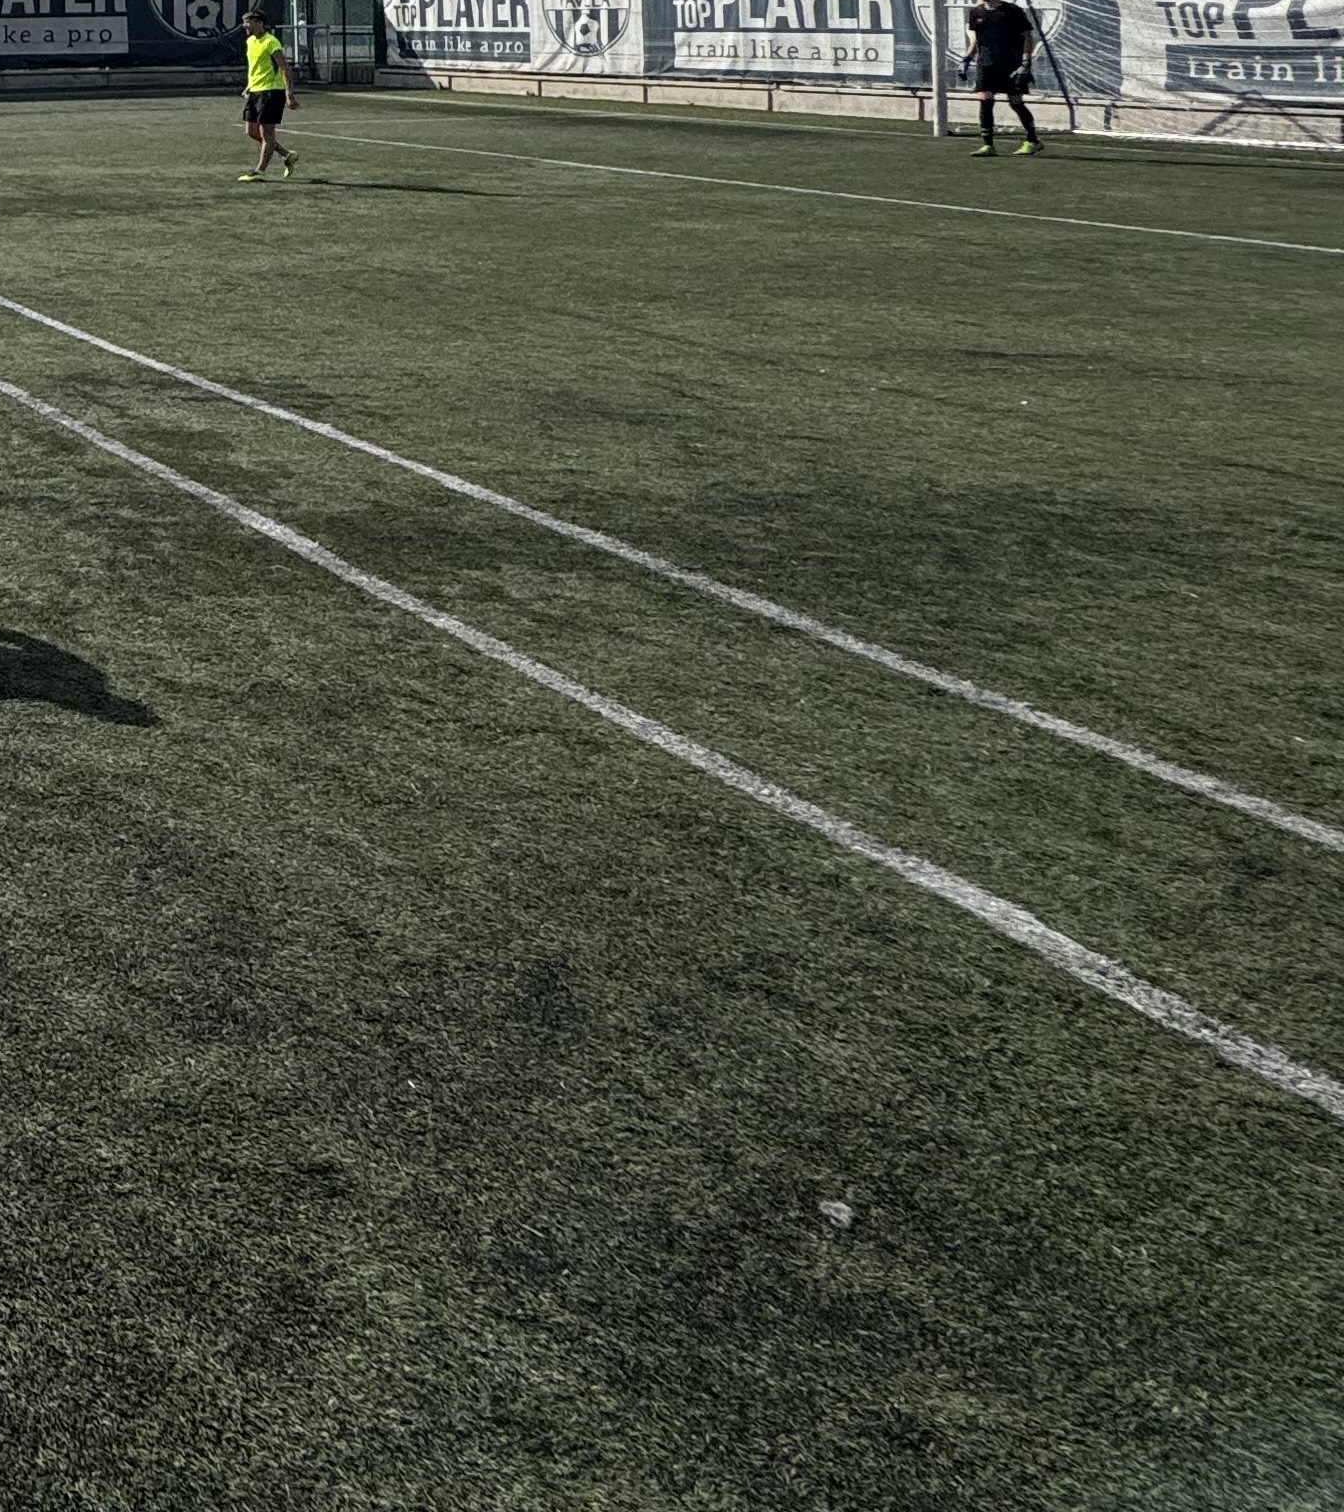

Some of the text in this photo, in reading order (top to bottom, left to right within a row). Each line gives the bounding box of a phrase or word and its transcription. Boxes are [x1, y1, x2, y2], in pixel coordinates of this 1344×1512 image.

[394, 5, 416, 28] TOP
[672, 0, 711, 29] TOP
[1155, 1, 1225, 38] TOP
[43, 31, 55, 42] a
[67, 27, 112, 48] pro
[443, 35, 472, 52] like
[479, 40, 490, 52] a
[493, 40, 524, 57] pro
[686, 39, 879, 66] train like a pro
[1187, 55, 1295, 81] train
